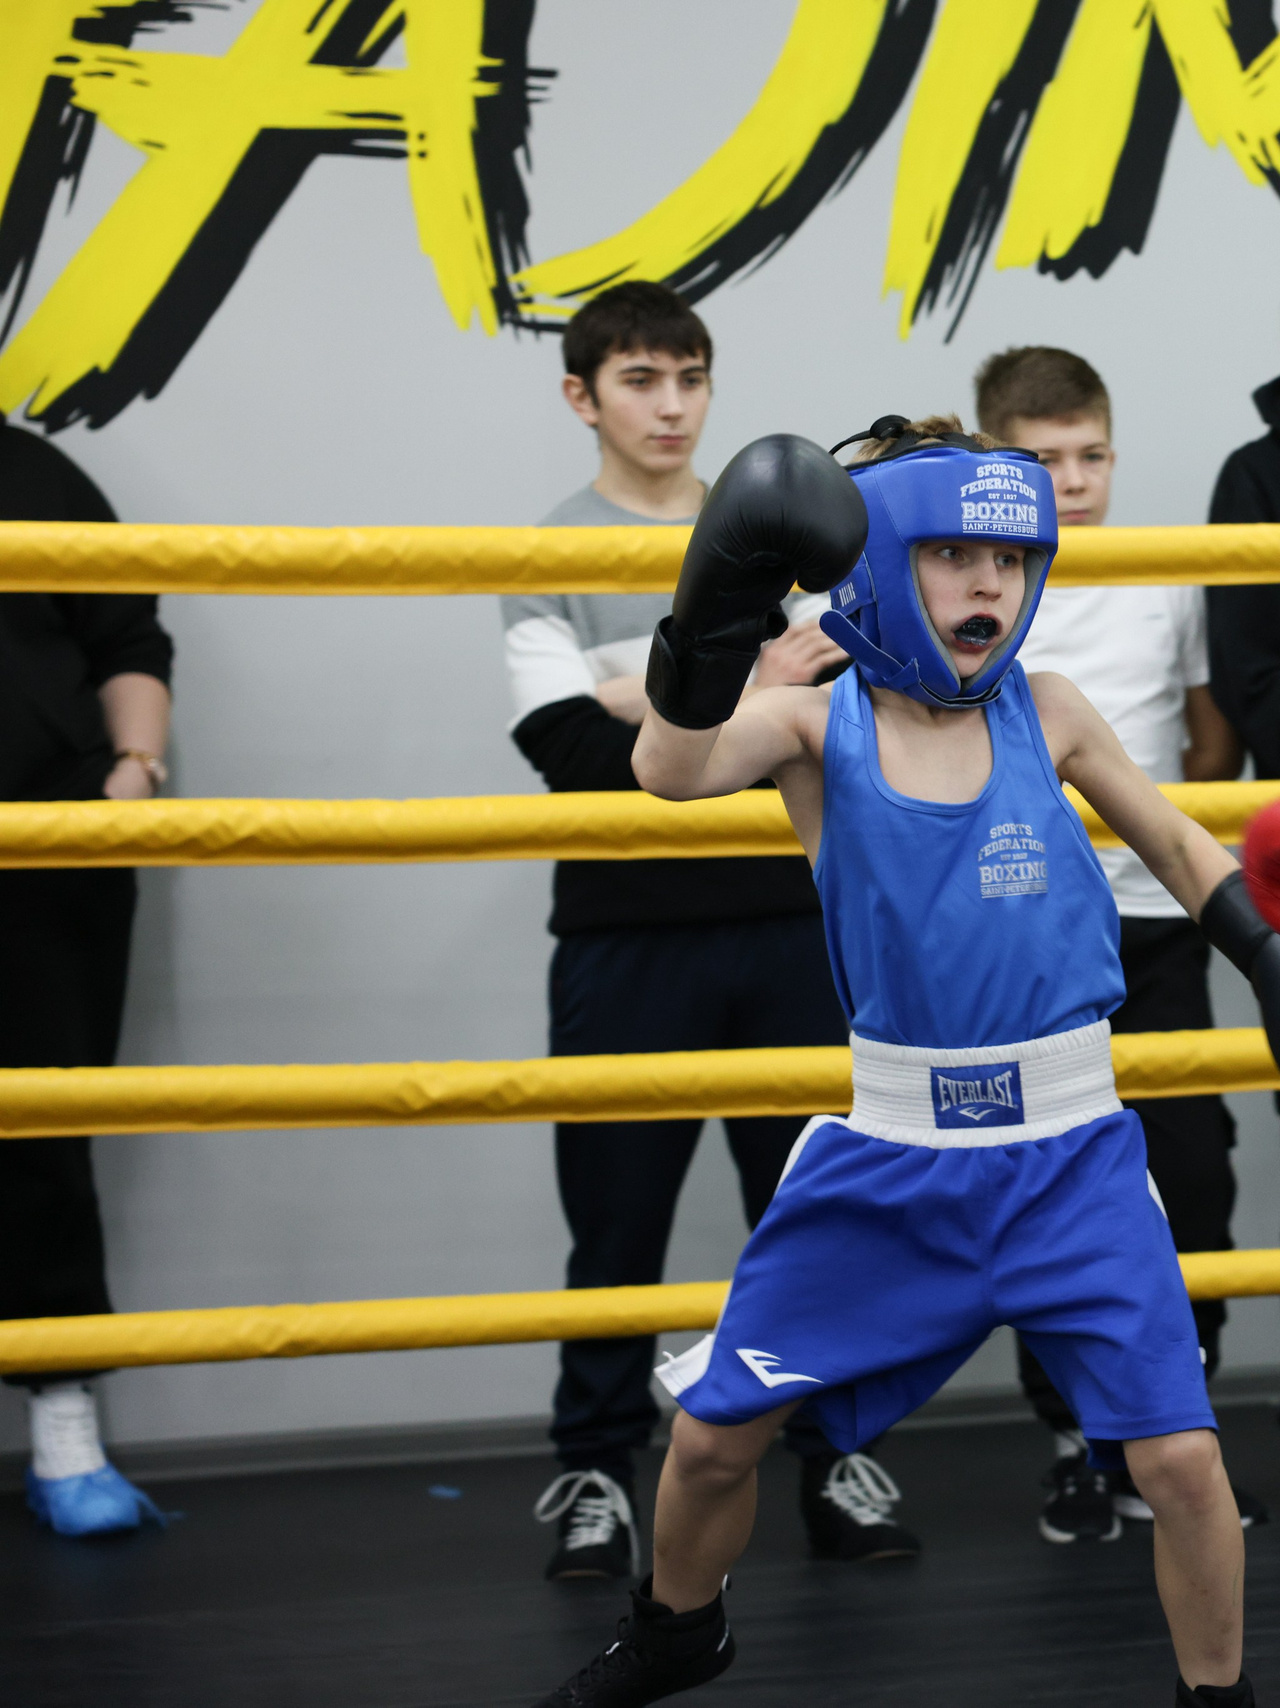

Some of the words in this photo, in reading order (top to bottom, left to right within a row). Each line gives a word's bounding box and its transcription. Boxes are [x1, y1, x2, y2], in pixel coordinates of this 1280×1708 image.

[976, 463, 1024, 480] SPORTS
[960, 478, 1037, 502] FEDERATION
[961, 502, 1038, 524] BOXING
[990, 823, 1033, 839] SPORTS
[978, 838, 1046, 862] FEDERATION
[979, 861, 1048, 884] BOXING
[937, 1070, 1013, 1112] EVERLAST
